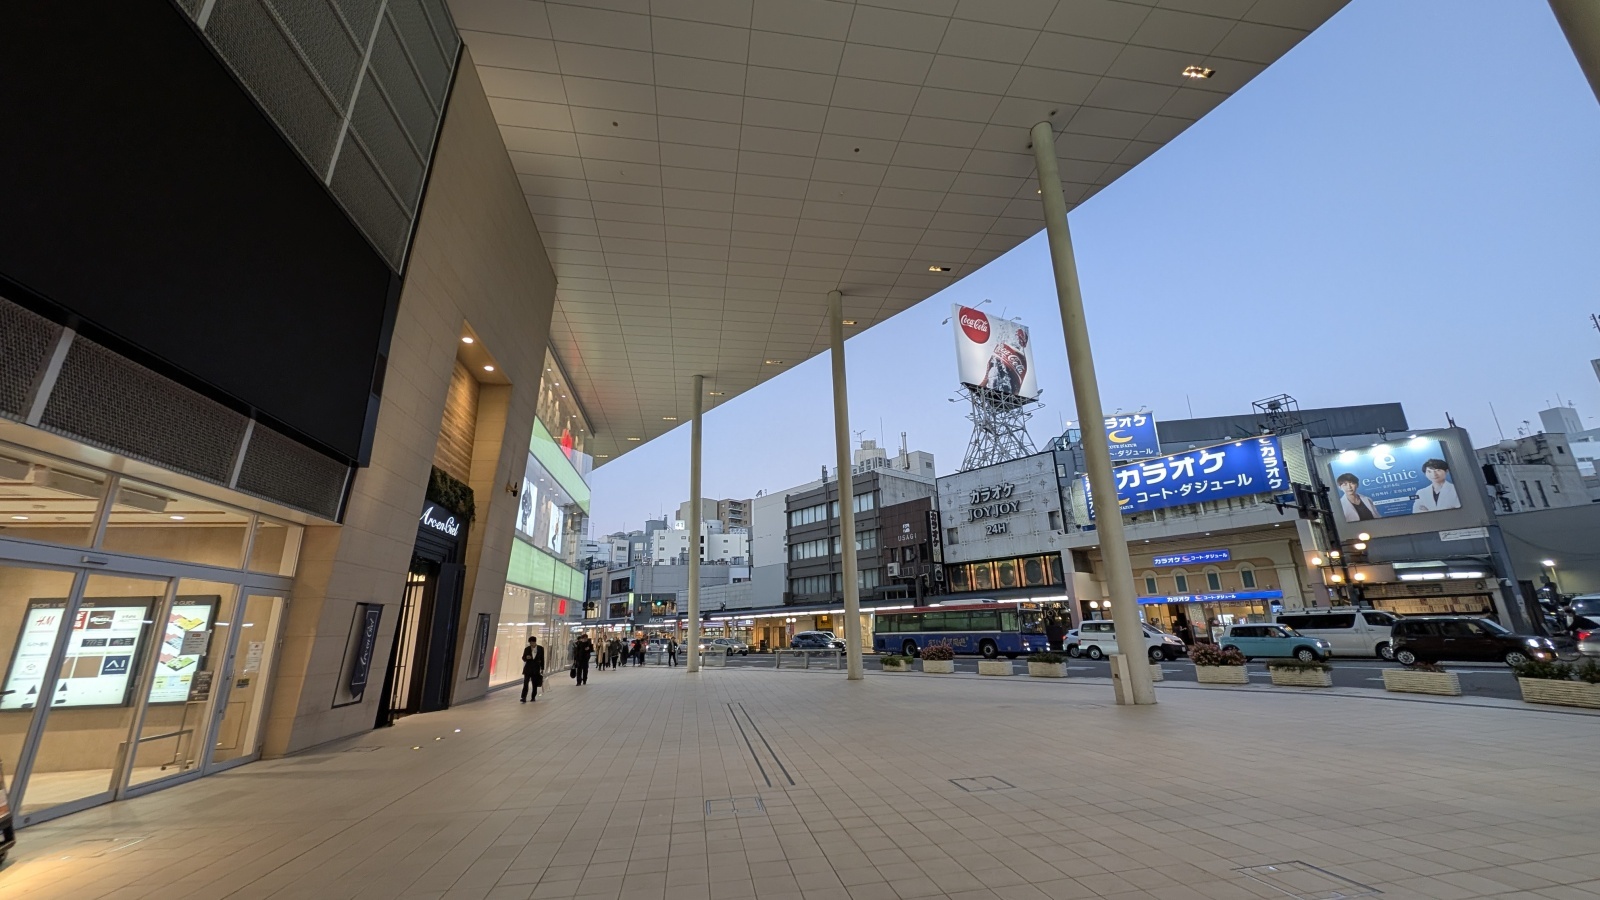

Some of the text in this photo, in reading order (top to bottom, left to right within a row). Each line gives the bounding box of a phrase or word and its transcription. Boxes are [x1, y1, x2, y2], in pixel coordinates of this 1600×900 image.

[961, 314, 989, 332] Coca-Cola
[1104, 415, 1147, 429] ラオケ
[1116, 451, 1226, 490] カラオケ
[1260, 446, 1282, 489] カラオケ
[1362, 469, 1418, 487] e-clinic
[970, 483, 1015, 504] カラオケ
[1136, 473, 1253, 503] コート・ダジュール
[967, 500, 1020, 522] JOY JOY
[898, 532, 917, 541] USAGI
[931, 512, 940, 548] カラオケ
[986, 523, 1007, 535] 24H
[1154, 556, 1180, 565] カラオケ
[37, 615, 56, 626] H&M
